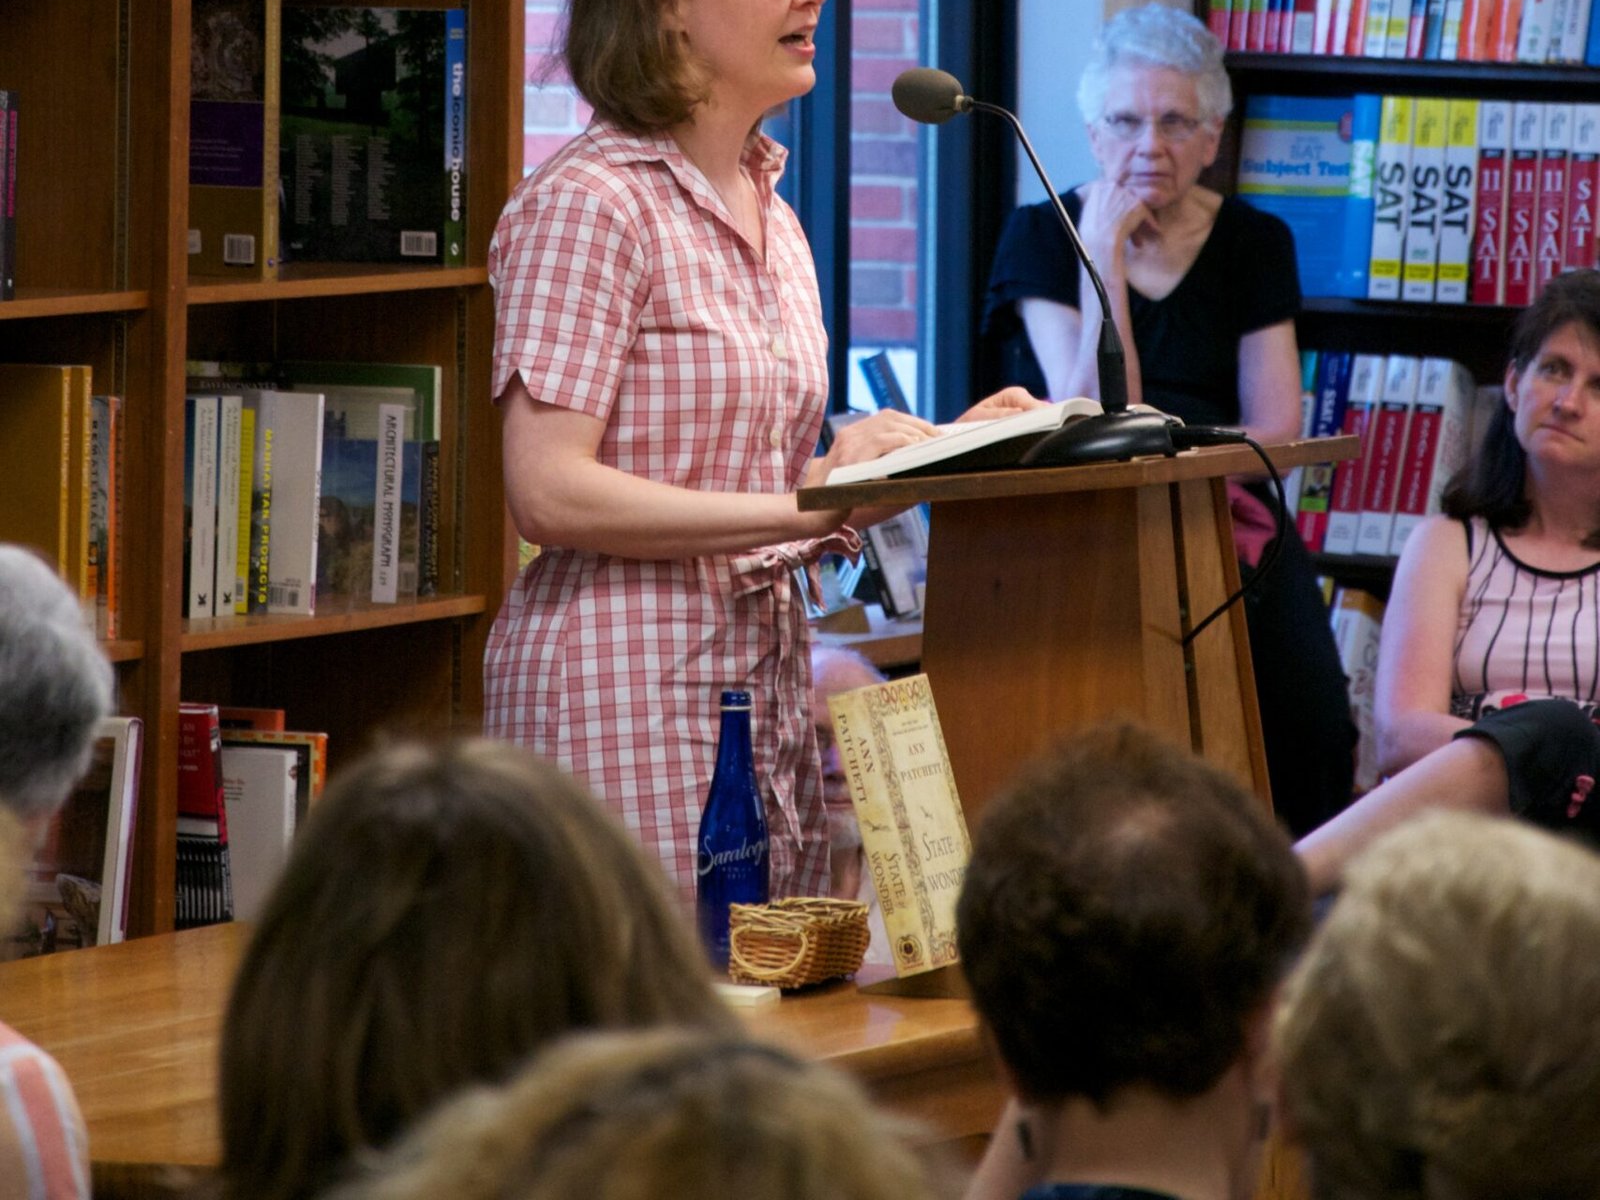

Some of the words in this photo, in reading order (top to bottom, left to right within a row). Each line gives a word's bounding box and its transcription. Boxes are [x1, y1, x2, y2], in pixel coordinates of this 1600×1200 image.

[1376, 161, 1405, 231] SAT
[1410, 165, 1440, 235] SAT
[1442, 164, 1472, 235] SAT
[1482, 169, 1500, 191] 11
[1514, 170, 1533, 192] 11
[1544, 169, 1563, 192] 11
[1572, 178, 1592, 247] SAT
[1477, 208, 1497, 280] SAT
[1509, 208, 1529, 281] SAT
[1539, 208, 1561, 280] SAT
[1319, 388, 1337, 423] SSAT
[261, 428, 273, 519] MANHATTAN
[383, 414, 397, 498] ARCHITECTURAL
[257, 525, 270, 604] PROJECTS
[837, 712, 868, 805] PATCHETT
[857, 736, 875, 774] ANN
[900, 762, 943, 783] PATCHETT
[908, 742, 927, 756] ANN
[871, 851, 895, 917] WONDER
[927, 866, 967, 892] WONDE
